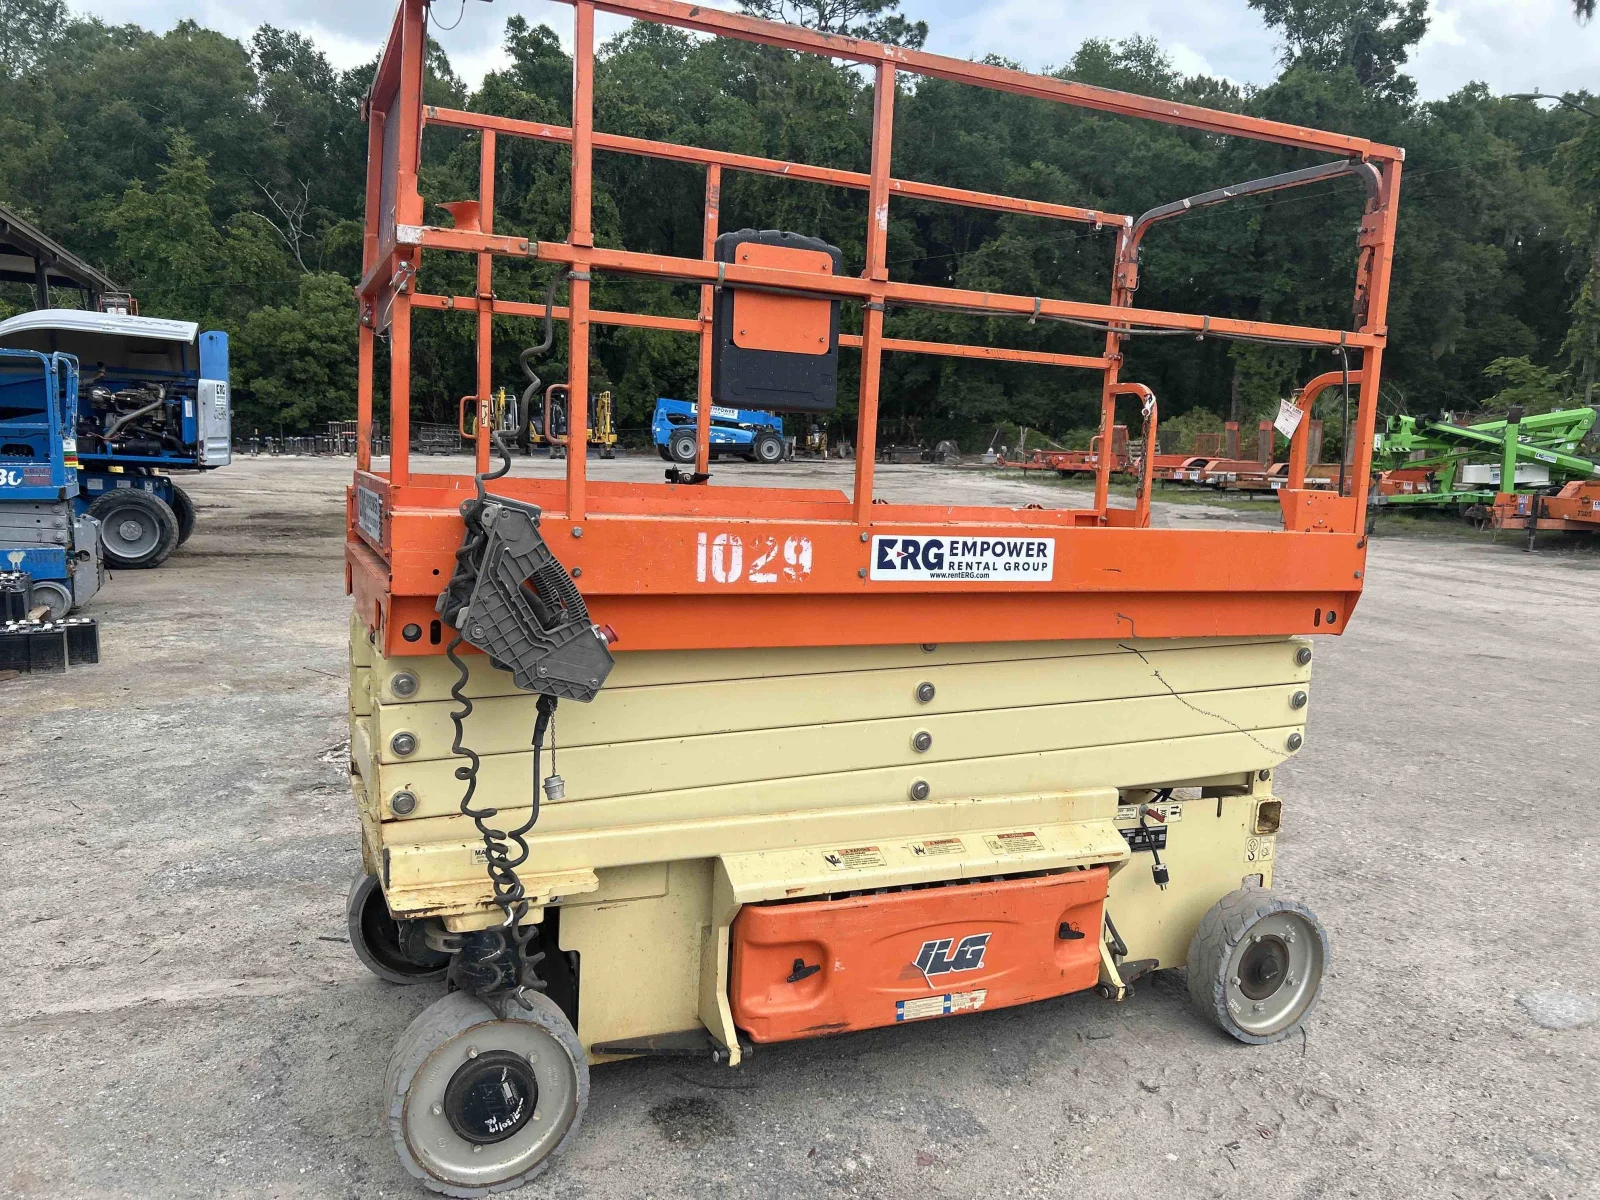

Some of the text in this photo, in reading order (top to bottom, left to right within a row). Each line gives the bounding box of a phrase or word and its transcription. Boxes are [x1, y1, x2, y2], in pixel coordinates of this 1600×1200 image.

[697, 532, 813, 583] 1029
[877, 538, 1048, 571] ERG EMPOWER
[949, 561, 1048, 571] RENTAL GROUP
[913, 932, 992, 977] JLG
